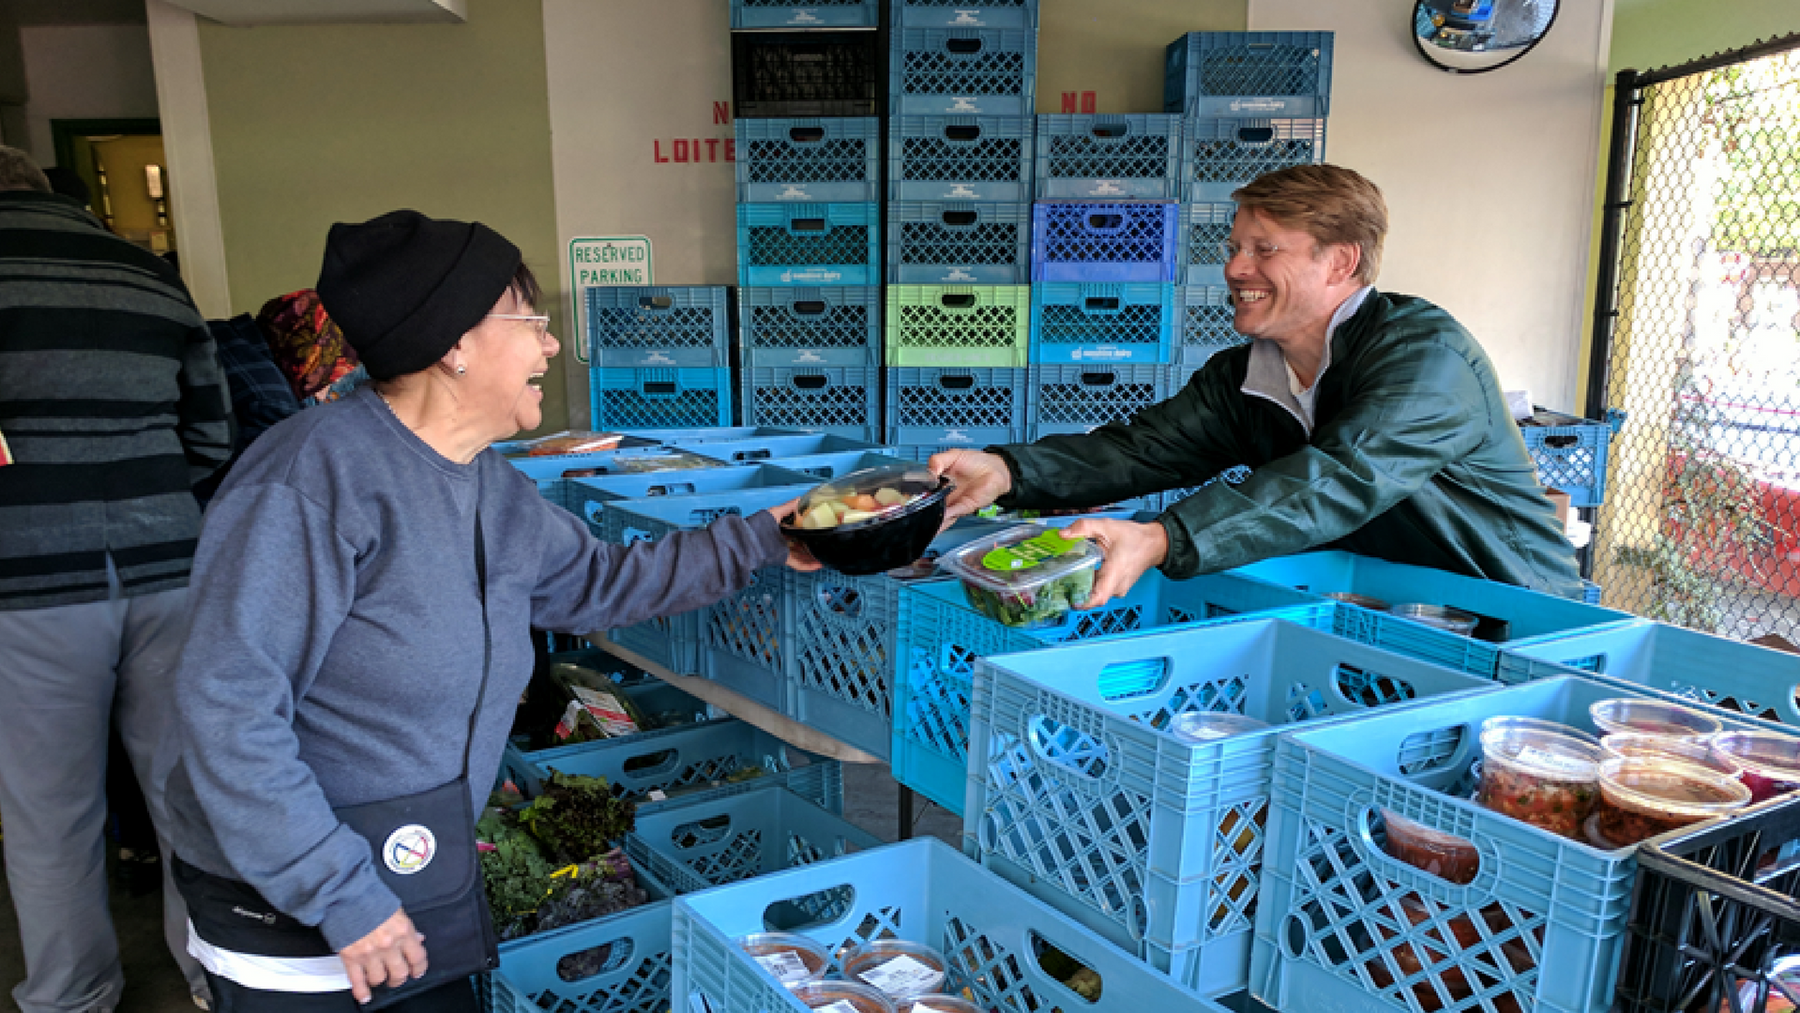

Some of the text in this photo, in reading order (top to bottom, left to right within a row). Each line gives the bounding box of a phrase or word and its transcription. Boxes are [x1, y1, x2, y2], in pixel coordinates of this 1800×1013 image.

[1061, 91, 1096, 114] NO
[654, 138, 735, 163] LOITE
[576, 246, 644, 263] RESERVED
[580, 268, 642, 284] PARKING
